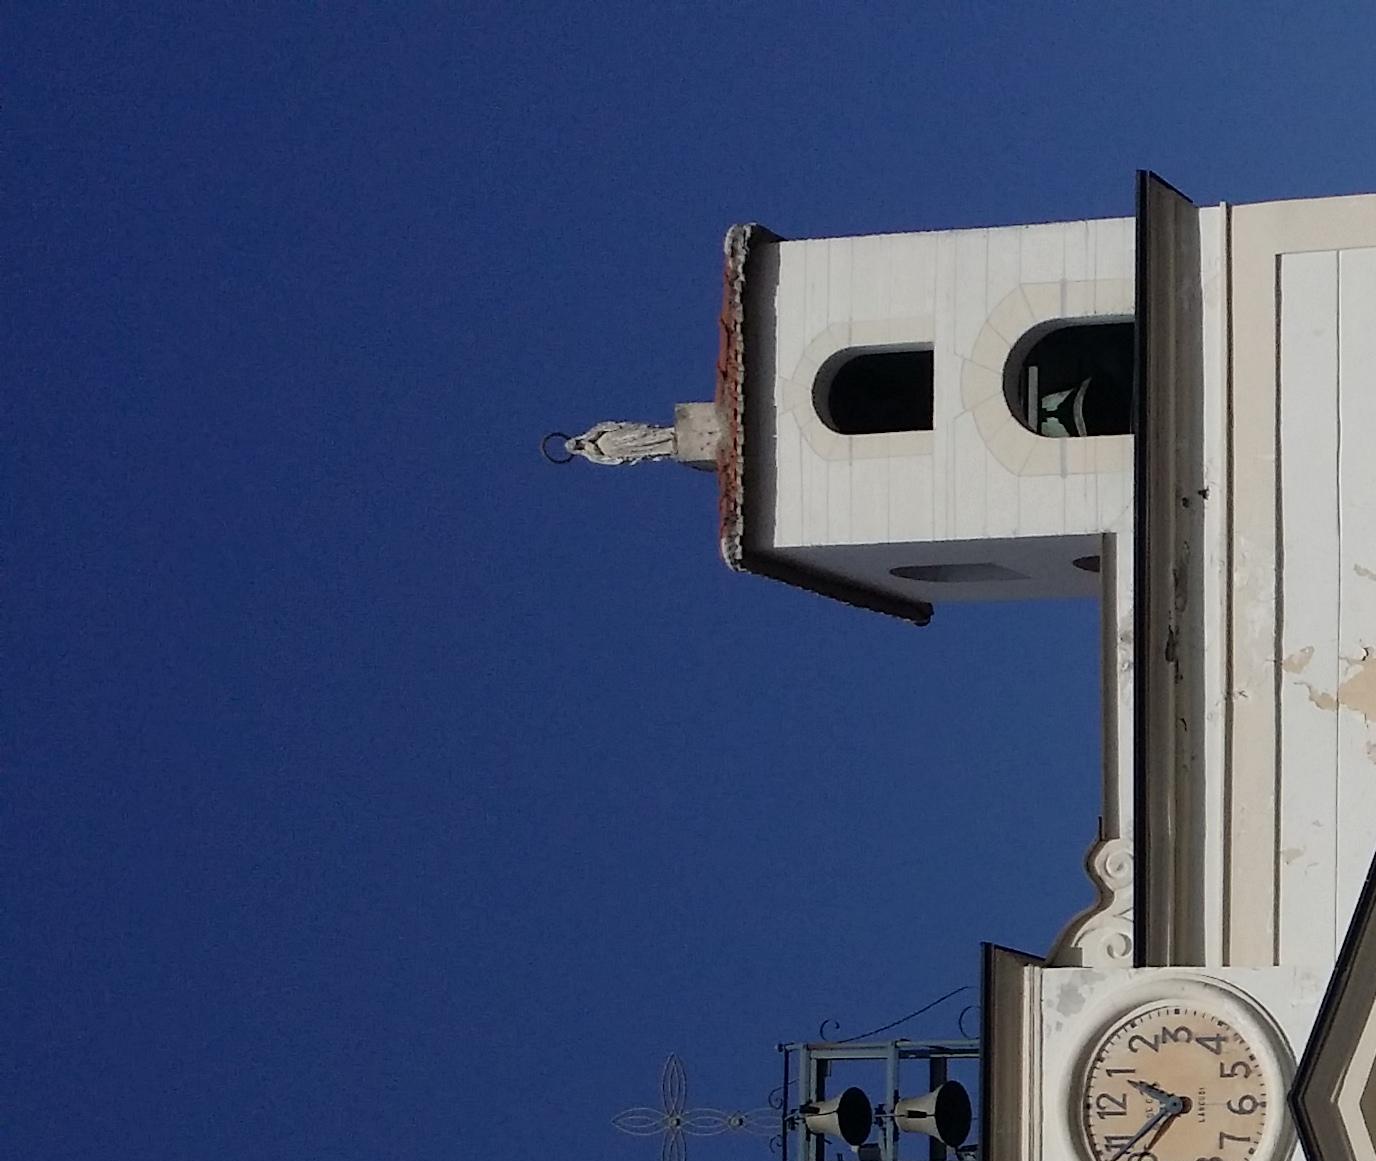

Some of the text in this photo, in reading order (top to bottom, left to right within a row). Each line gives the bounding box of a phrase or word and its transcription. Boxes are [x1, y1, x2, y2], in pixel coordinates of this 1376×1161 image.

[1128, 1034, 1158, 1053] 2
[1162, 1026, 1192, 1044] 3
[1195, 1034, 1228, 1055] 4
[1105, 1068, 1136, 1077] 1
[1220, 1061, 1250, 1079] 5
[1096, 1093, 1127, 1120] 12
[1226, 1094, 1258, 1115] 6
[1220, 1132, 1250, 1149] 7
